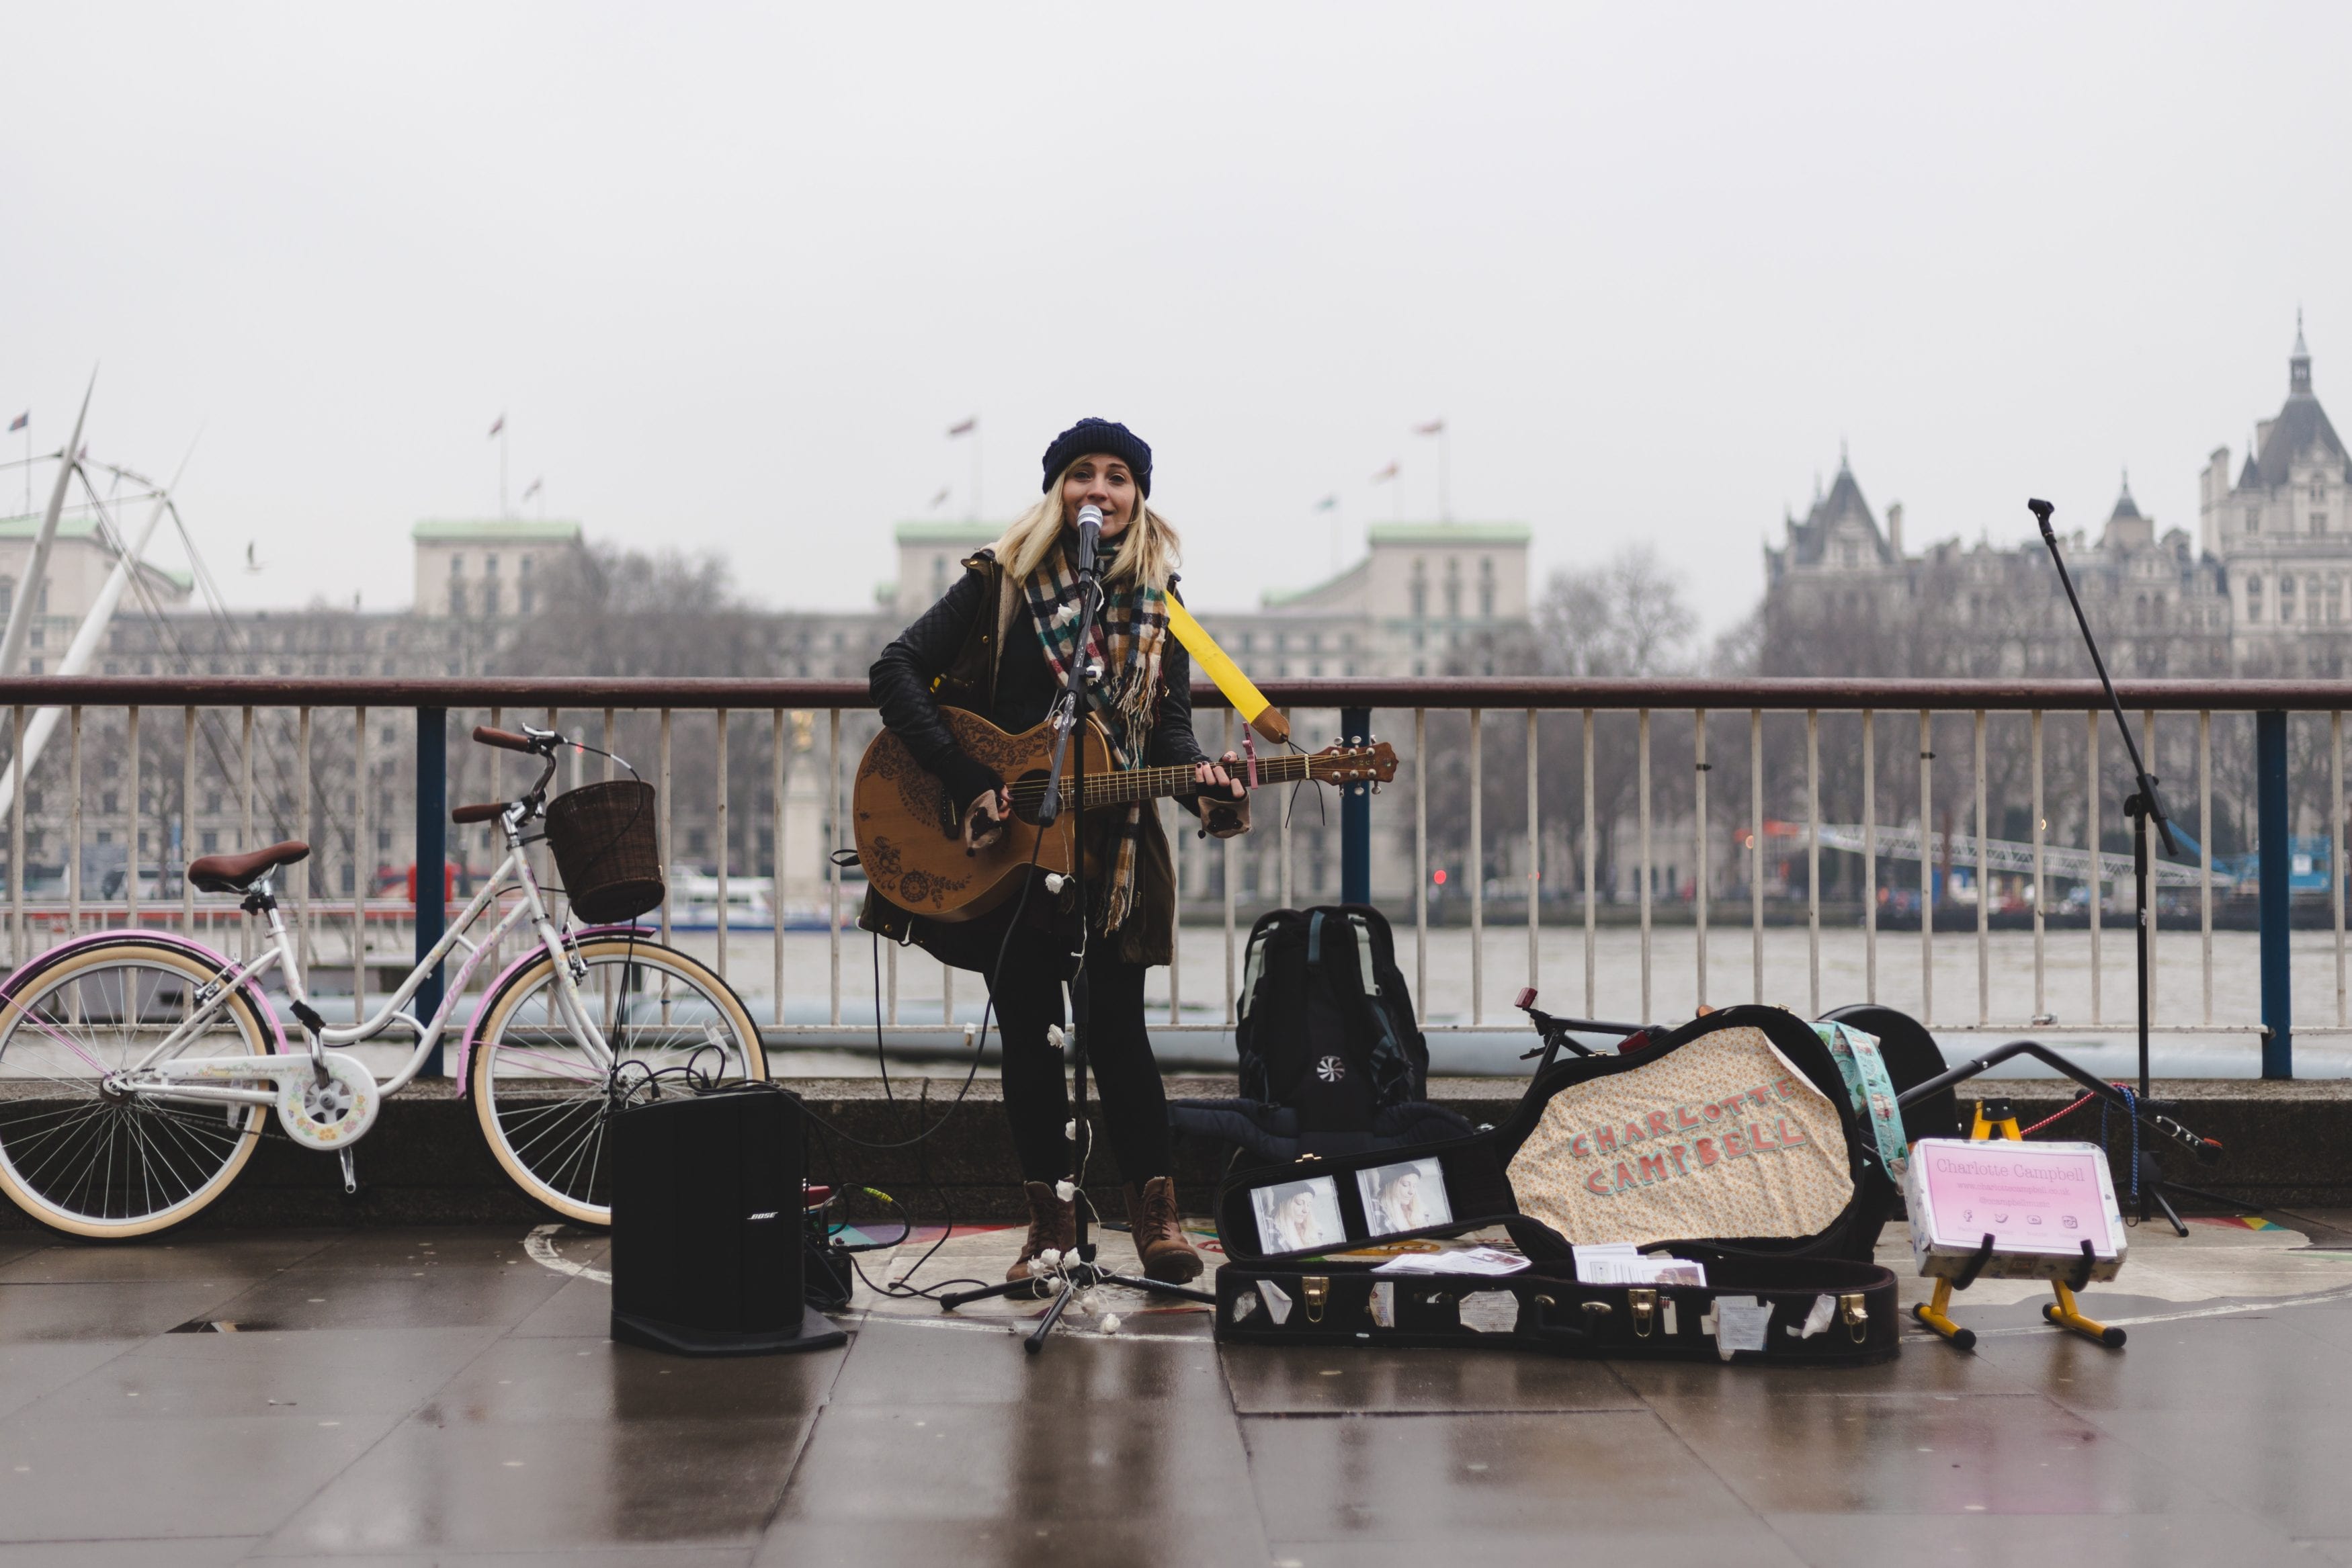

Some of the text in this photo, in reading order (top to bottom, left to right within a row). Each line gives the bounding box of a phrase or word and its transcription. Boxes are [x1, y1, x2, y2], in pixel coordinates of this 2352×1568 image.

[1568, 1076, 1798, 1158] CHARLOTTE
[1583, 1115, 1807, 1195] CAMPBELL
[1936, 1158, 2085, 1182] Charlotte Campbell
[747, 1212, 778, 1220] BOSE
